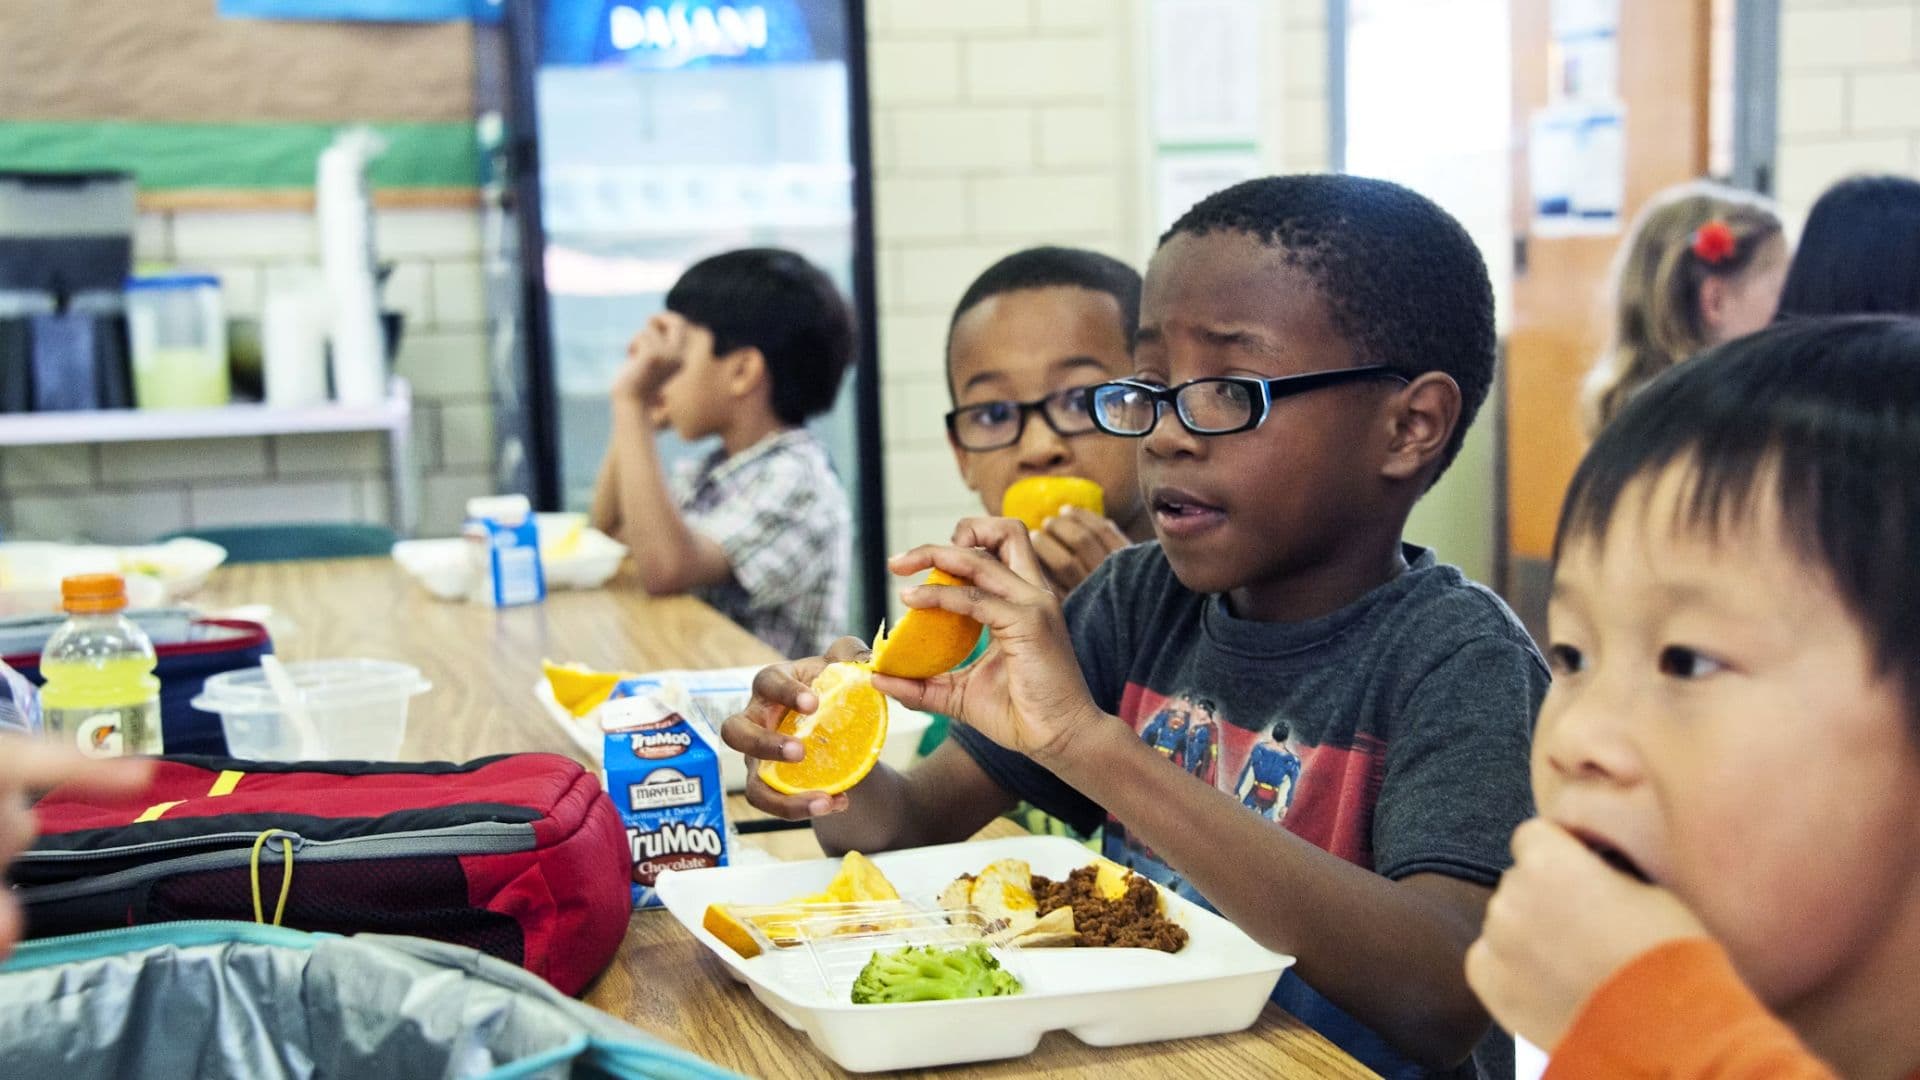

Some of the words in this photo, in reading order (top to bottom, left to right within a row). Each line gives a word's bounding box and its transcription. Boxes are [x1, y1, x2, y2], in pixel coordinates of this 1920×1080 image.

[609, 5, 767, 50] DASANI
[77, 711, 123, 759] G
[630, 732, 692, 751] TruMoo
[636, 783, 695, 800] MAYFIELD
[626, 823, 722, 862] TruMoo
[637, 857, 707, 875] Chocolate
